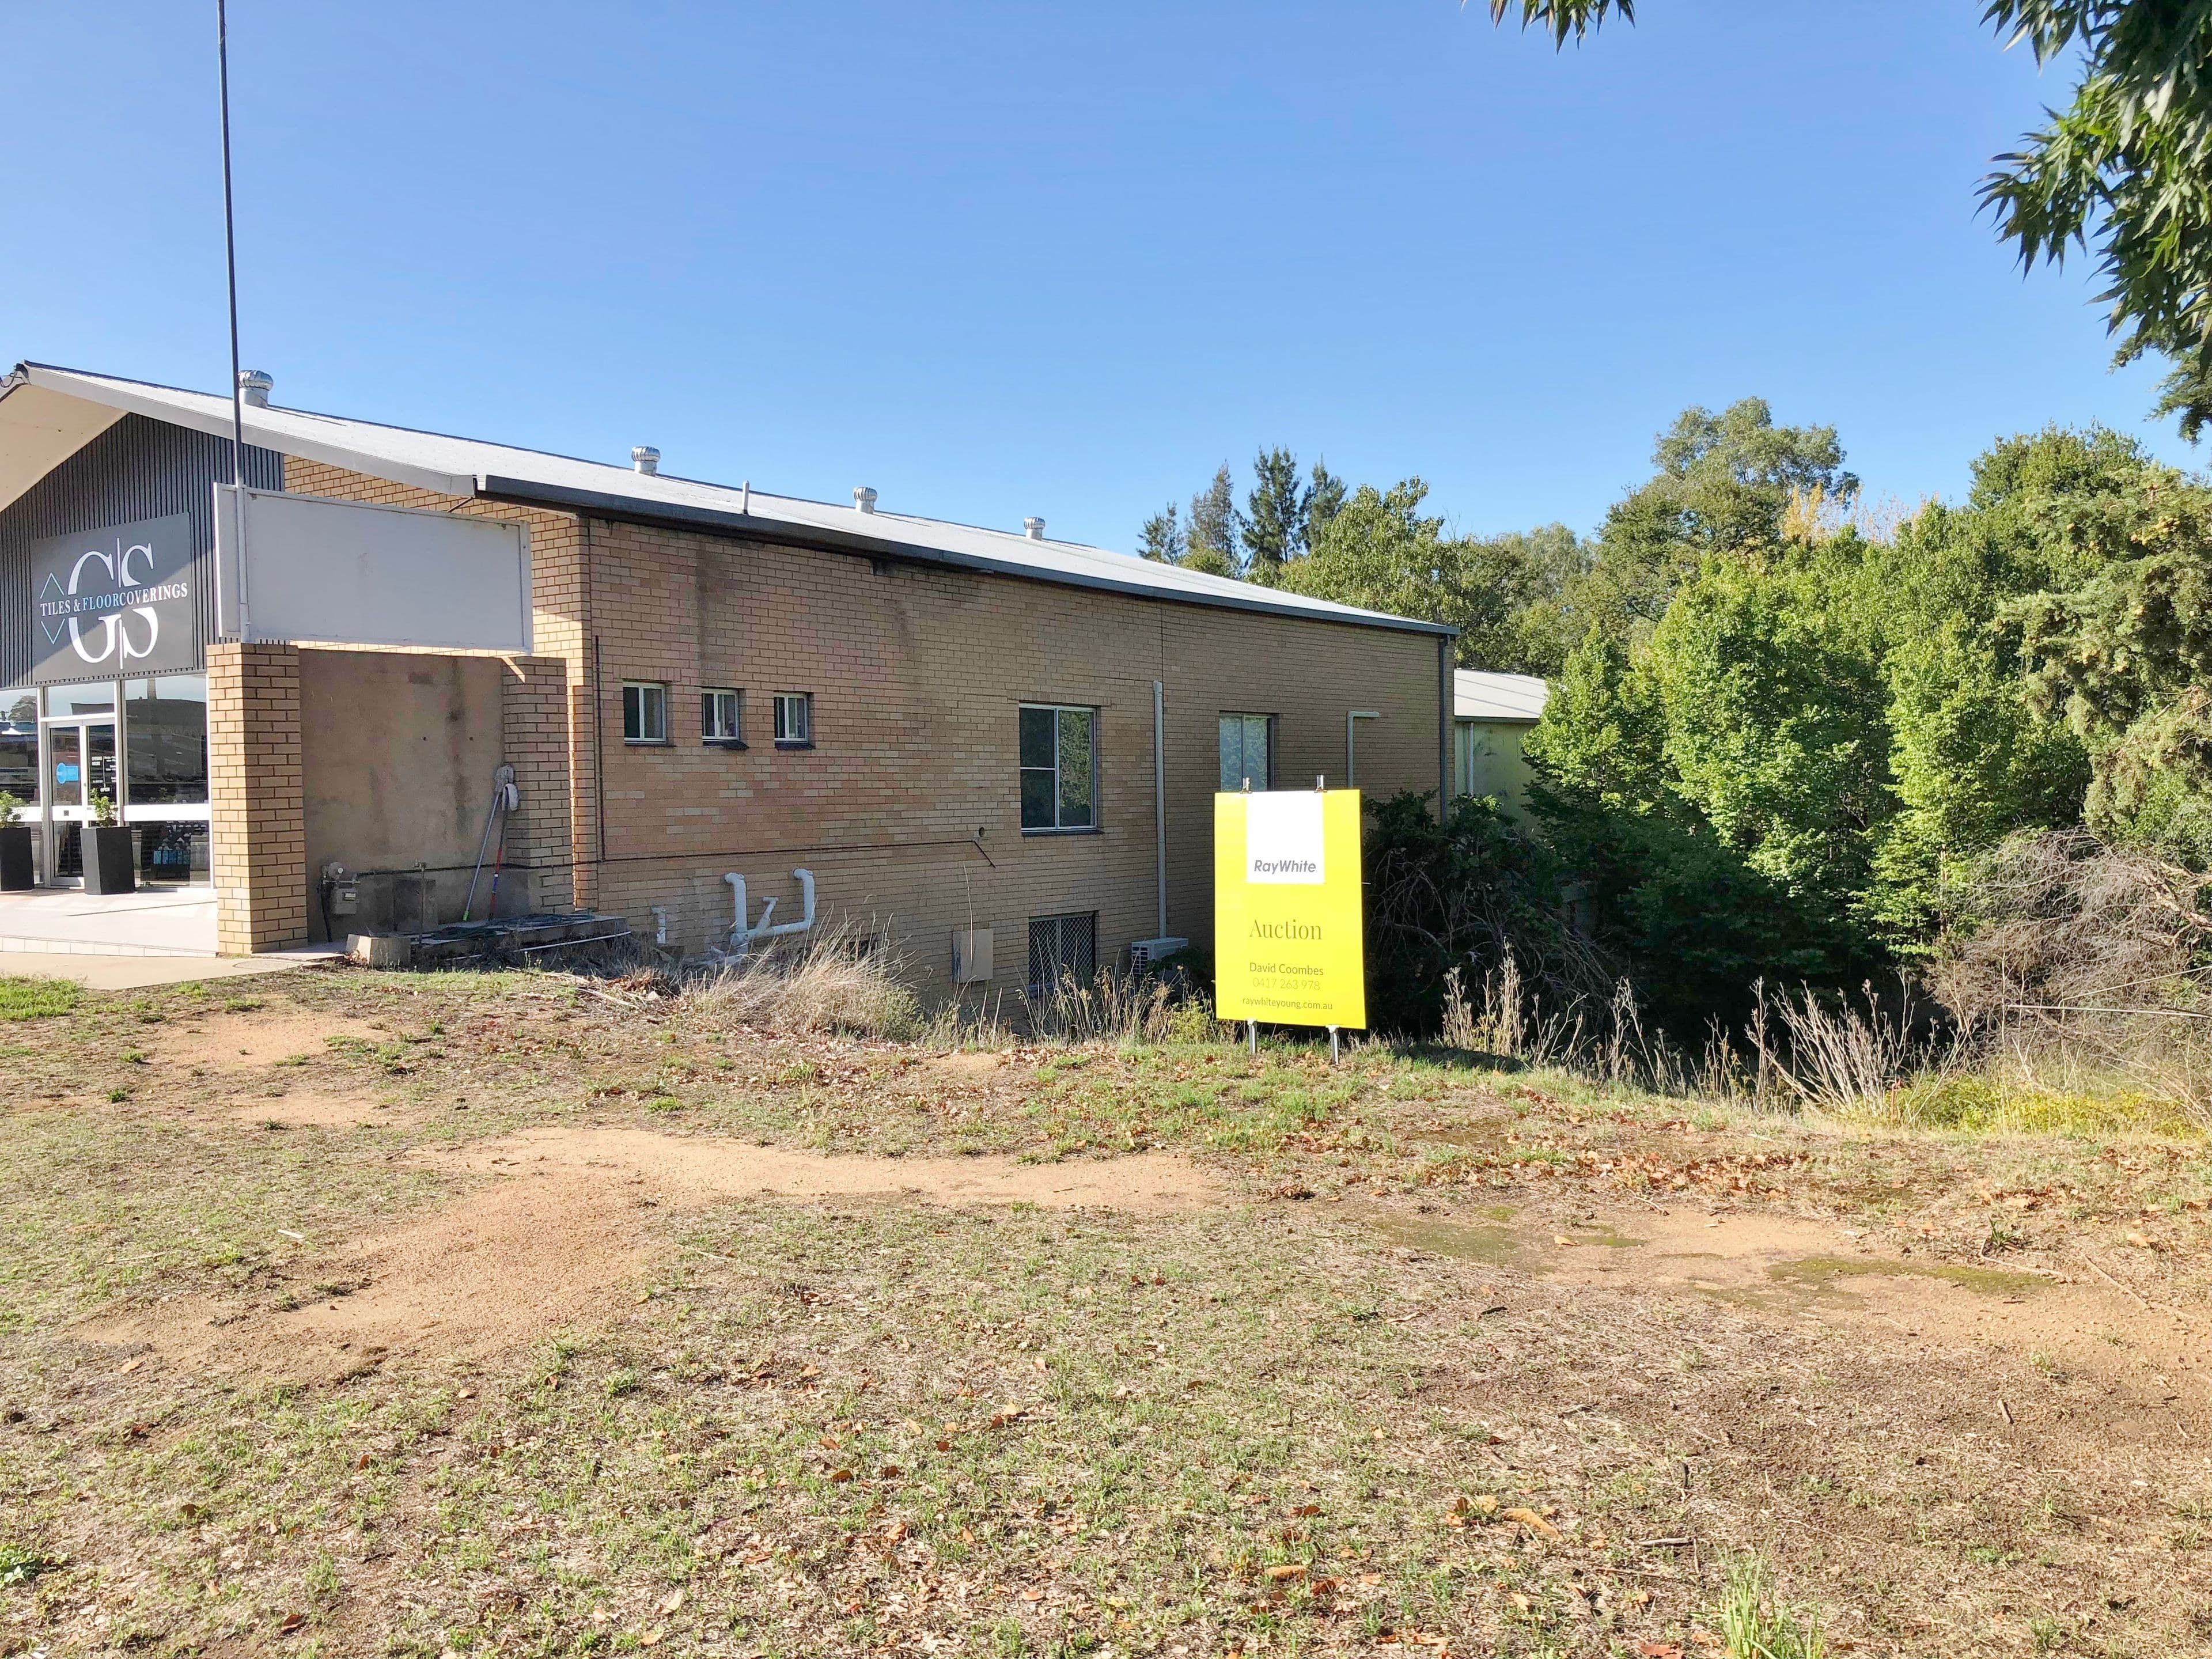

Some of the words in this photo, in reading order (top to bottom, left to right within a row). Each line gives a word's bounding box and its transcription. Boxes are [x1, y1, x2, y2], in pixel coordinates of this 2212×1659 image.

[40, 600, 71, 617] TILES
[73, 599, 81, 612] &
[82, 582, 188, 612] FLOORCOVERINGS
[1249, 918, 1323, 940] Auction
[1249, 962, 1276, 973] David
[1279, 964, 1324, 976] Coombes
[1253, 977, 1277, 988] 0417
[1280, 979, 1298, 990] 263
[1301, 980, 1320, 991] 978
[1243, 997, 1333, 1010] raywhiteyoung.com.au
